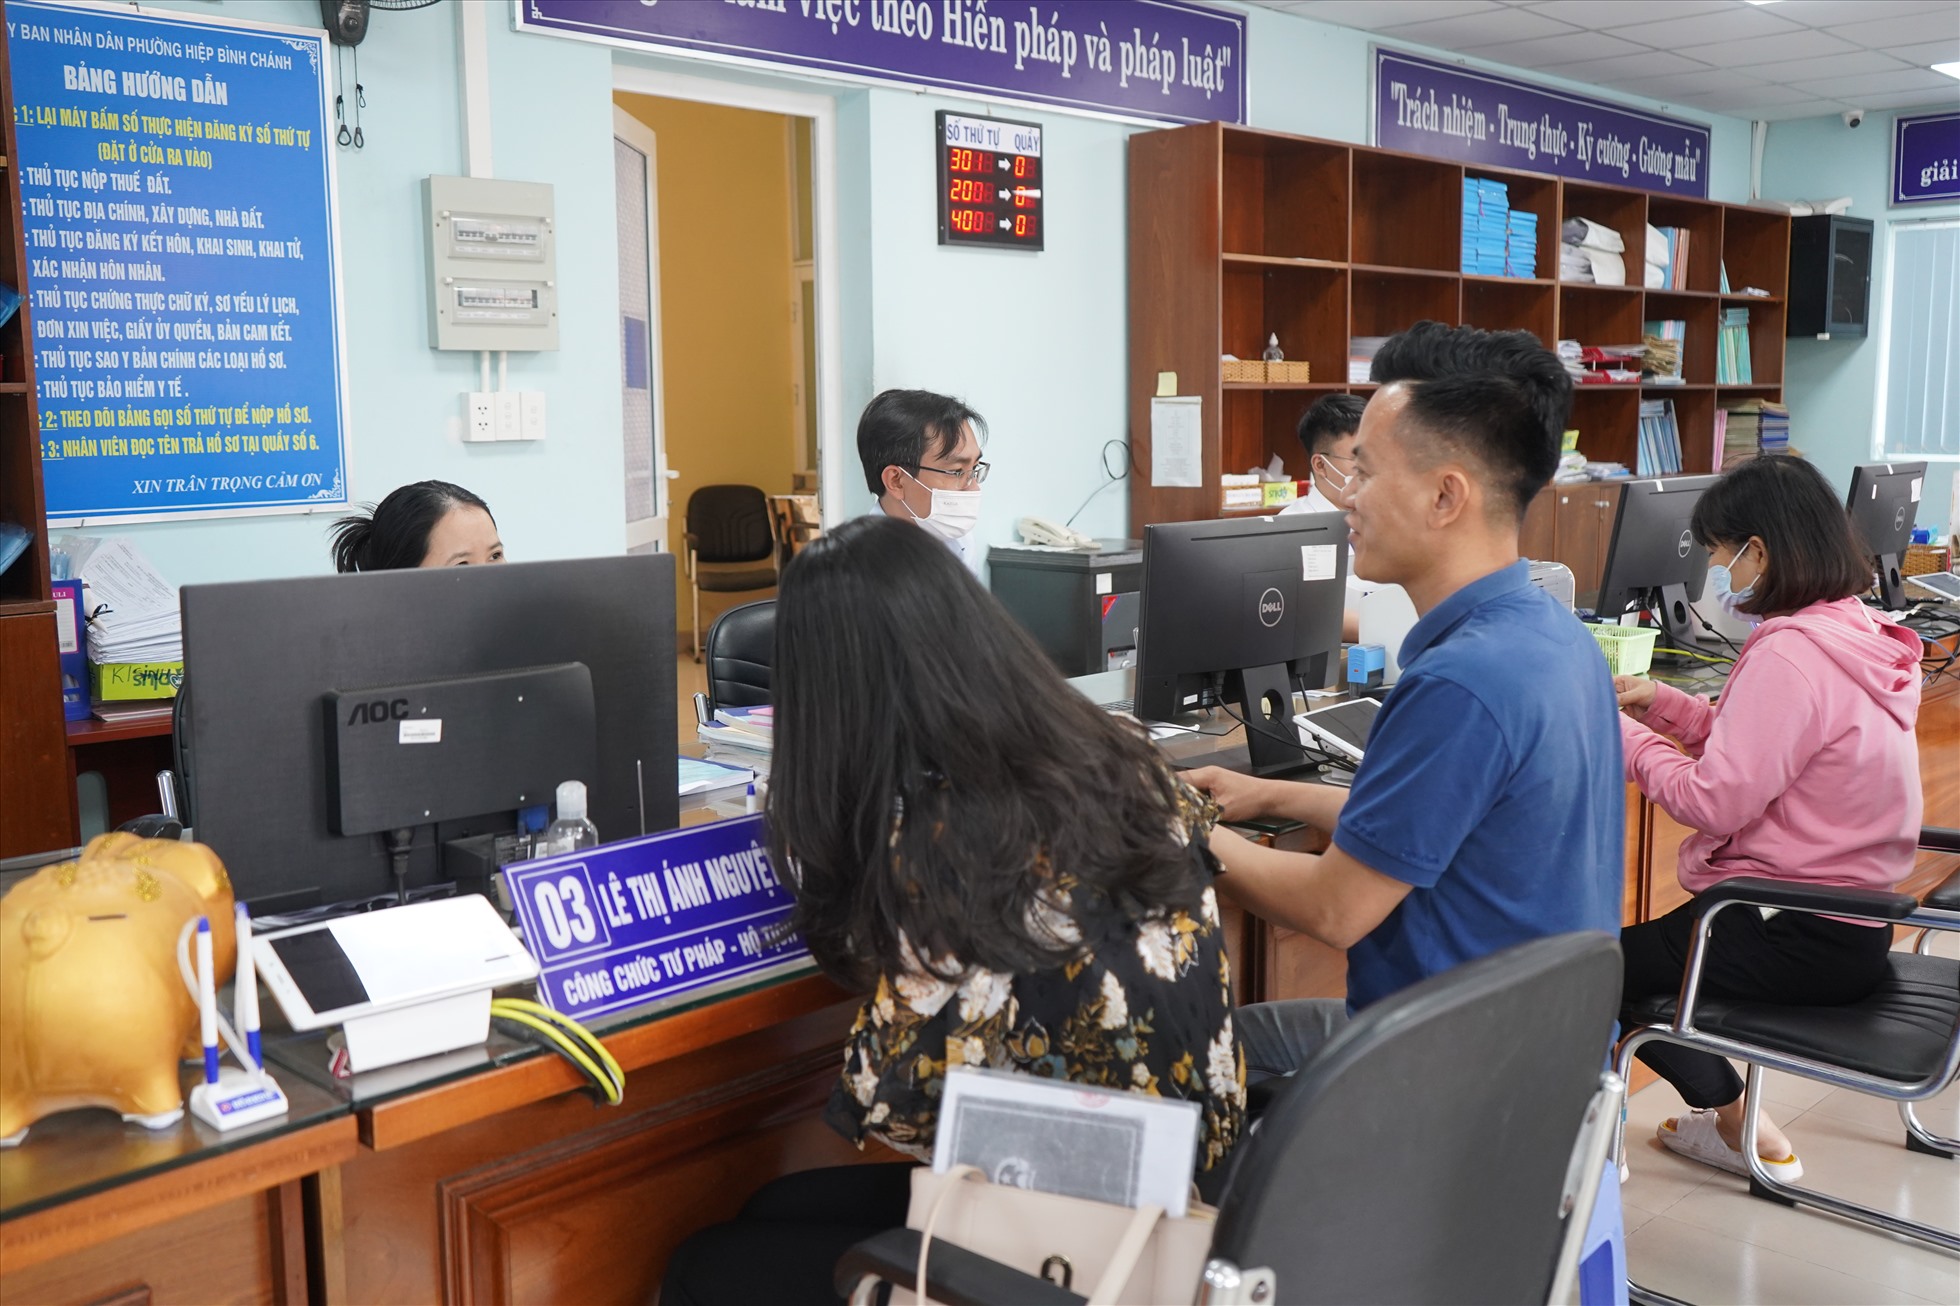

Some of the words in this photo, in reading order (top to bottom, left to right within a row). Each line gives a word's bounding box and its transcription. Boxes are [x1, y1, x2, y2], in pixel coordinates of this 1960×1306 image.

[21, 24, 49, 42] BAN
[54, 26, 92, 47] NHÂN
[96, 30, 124, 51] DÂN
[127, 36, 182, 58] PHƯỜNG
[185, 42, 214, 63] HIỆP
[218, 45, 247, 66] BÌNH
[250, 51, 292, 70] CHÁNH
[871, 0, 933, 40] theo
[1014, 6, 1078, 78] pháp
[1084, 20, 1112, 73] và
[1119, 28, 1176, 95] pháp
[1181, 37, 1231, 100] luật"
[63, 60, 117, 95] BẢNG
[122, 70, 186, 102] HƯỚNG
[191, 73, 228, 106] DẪN
[36, 106, 57, 129] LẠI
[60, 106, 87, 128] MÁY
[91, 106, 119, 131] BẤM
[122, 109, 139, 132] SỐ
[141, 115, 172, 139] THỰC
[175, 116, 203, 141] HIỆN
[205, 119, 236, 142] ĐĂNG
[239, 122, 253, 143] KÝ
[256, 122, 271, 144] SỐ
[273, 126, 295, 146] THỨ
[296, 129, 311, 151] TỰ
[947, 118, 961, 141] SỐ
[963, 123, 985, 145] THỨ
[987, 127, 1001, 149] TỰ
[1014, 128, 1040, 152] QUẦY
[1391, 80, 1439, 132] "Trách
[1443, 94, 1486, 147] nhiệm
[1498, 103, 1538, 160] Trung
[1540, 113, 1568, 166] thực
[1577, 121, 1594, 172] Kỷ
[1596, 132, 1631, 179] cương
[1639, 135, 1673, 187] Gương
[1674, 138, 1701, 182] mẫu"
[27, 162, 51, 186] THỦ
[54, 169, 79, 192] TỤC
[82, 168, 107, 193] NỘP
[110, 169, 141, 193] THUẾ
[147, 170, 172, 194] ĐẤT.
[1920, 159, 1958, 188] giải
[29, 193, 54, 217] THỦ
[57, 199, 81, 222] TỤC
[84, 201, 106, 224] ĐỊA
[108, 200, 149, 225] CHÍNH,
[152, 202, 174, 224] XÂY
[177, 206, 213, 229] DỰNG,
[215, 207, 240, 227] NHÀ
[241, 206, 265, 229] ĐẤT.
[31, 224, 57, 248] THỦ
[59, 230, 84, 252] TỤC
[86, 229, 121, 250] ĐĂNG
[123, 230, 139, 252] KÝ
[142, 229, 163, 253] KẾT
[166, 232, 195, 256] HÔN,
[197, 237, 223, 255] KHAI
[226, 238, 257, 259] SINH,
[259, 240, 285, 258] KHAI
[286, 236, 304, 261] TỬ,
[32, 256, 59, 278] XÁC
[61, 258, 97, 283] NHẬN
[100, 259, 126, 280] HÔN
[128, 261, 166, 282] NHÂN.
[36, 284, 61, 308] THỦ
[63, 291, 88, 313] TỤC
[91, 288, 132, 310] CHỨNG
[135, 292, 165, 314] THỰC
[168, 291, 193, 311] CHỮ
[194, 291, 213, 314] KÝ,
[215, 294, 231, 313] SƠ
[233, 290, 255, 313] YẾU
[257, 293, 269, 314] LÝ
[272, 296, 300, 317] LỊCH,
[37, 318, 64, 339] ĐƠN
[67, 321, 89, 339] XIN
[91, 318, 123, 343] VIỆC,
[125, 316, 153, 340] GIẤY
[155, 317, 171, 340] ỦY
[174, 317, 215, 342] QUYỀN,
[217, 318, 241, 341] BẢN
[243, 324, 268, 341] CAM
[270, 319, 293, 342] KẾT.
[41, 345, 65, 369] THỦ
[68, 351, 92, 372] TỤC
[95, 351, 119, 369] SAO
[121, 351, 130, 369] Y
[132, 346, 158, 369] BẢN
[160, 348, 196, 369] CHÍNH
[198, 348, 222, 369] CÁC
[224, 352, 249, 373] LOẠI
[251, 347, 266, 369] HỒ
[268, 351, 287, 369] SƠ.
[43, 375, 68, 398] THỦ
[70, 380, 95, 402] TỤC
[97, 375, 122, 398] BẢO
[124, 374, 155, 398] HIỂM
[157, 380, 165, 397] Y
[167, 375, 182, 398] TẾ
[60, 410, 91, 428] THEO
[94, 406, 115, 427] DÕI
[118, 404, 151, 427] BẢNG
[153, 408, 174, 430] GỌI
[176, 403, 192, 426] SỐ
[194, 405, 217, 426] THỨ
[218, 406, 233, 429] TỰ
[234, 401, 250, 425] ĐỂ
[251, 404, 275, 428] NỘP
[277, 402, 292, 424] HỒ
[294, 405, 312, 424] SƠ.
[62, 436, 98, 458] NHÂN
[100, 435, 129, 457] VIÊN
[131, 438, 155, 459] ĐỌC
[157, 434, 180, 455] TÊN
[182, 431, 205, 454] TRẢ
[206, 431, 222, 453] HỒ
[224, 434, 240, 453] SƠ
[242, 435, 260, 456] TẠI
[262, 429, 290, 453] QUẦY
[292, 429, 307, 451] SỐ
[309, 434, 320, 450] 6.
[132, 479, 162, 494] XIN
[166, 475, 208, 493] TRÂN
[211, 476, 263, 493] TRỌNG
[265, 471, 299, 489] CẢM
[301, 473, 323, 486] ƠN
[1262, 602, 1282, 614] DELL
[347, 698, 409, 726] AOC
[598, 871, 634, 928] LÊ
[626, 872, 672, 925] THỊ
[662, 859, 710, 913] ÁNH
[533, 875, 597, 950] 03
[562, 971, 614, 1006] CÔNG
[612, 955, 661, 994] CHỨC
[659, 947, 684, 979] TƯ
[682, 936, 727, 973] PHÁP
[737, 925, 763, 958] HỘ
